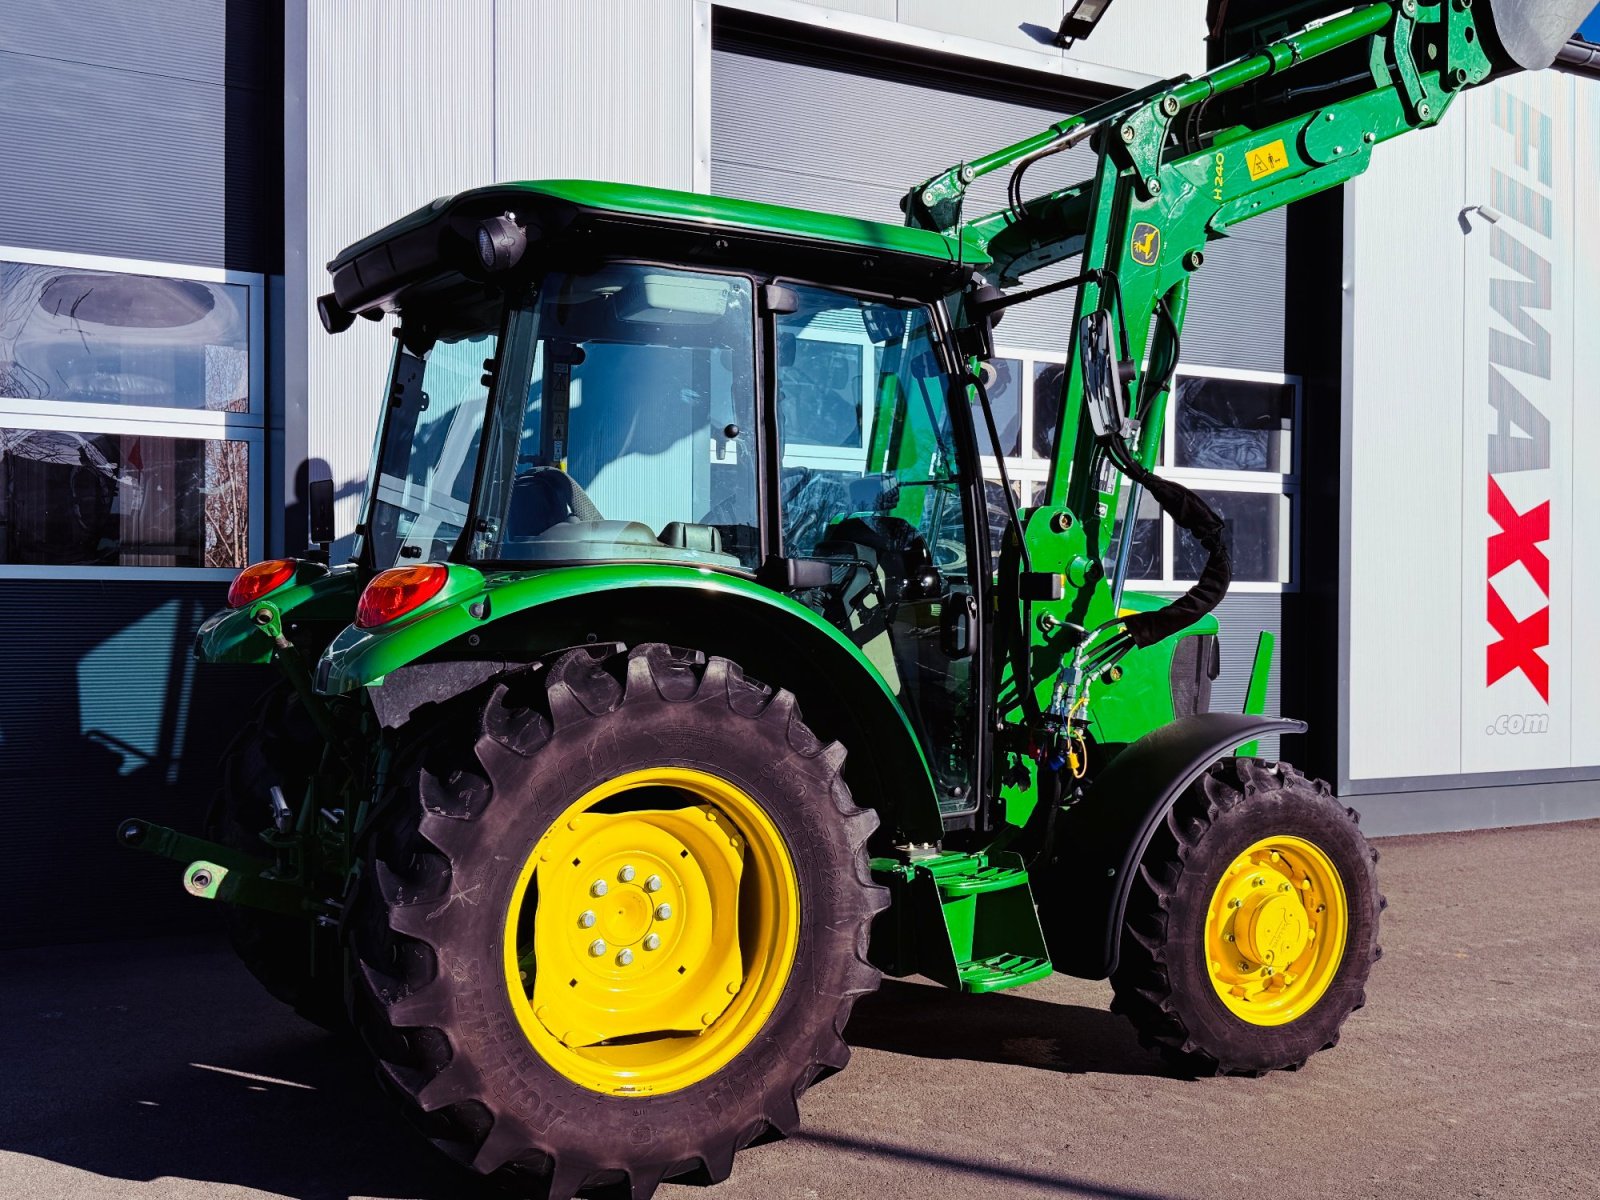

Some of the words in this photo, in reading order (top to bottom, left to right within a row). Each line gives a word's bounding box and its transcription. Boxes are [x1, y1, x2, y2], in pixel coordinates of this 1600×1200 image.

[1214, 152, 1225, 187] 240
[1213, 188, 1222, 200] H
[1487, 84, 1552, 706] FIMAXX
[1485, 713, 1550, 736] .com
